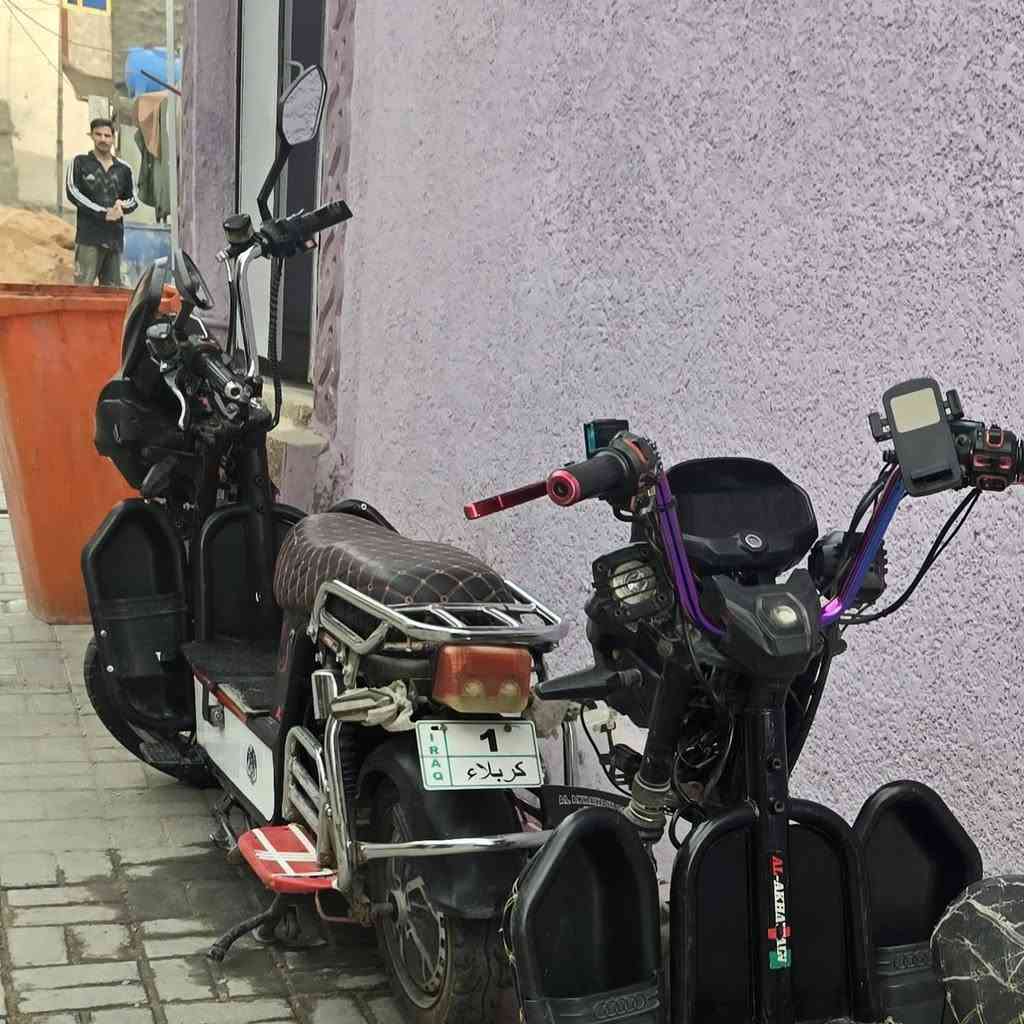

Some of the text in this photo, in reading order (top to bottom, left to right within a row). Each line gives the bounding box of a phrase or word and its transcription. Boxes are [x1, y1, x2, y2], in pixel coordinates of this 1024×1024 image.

[479, 728, 498, 752] 1
[429, 733, 444, 781] IRAQ
[466, 761, 527, 782] كربلاء
